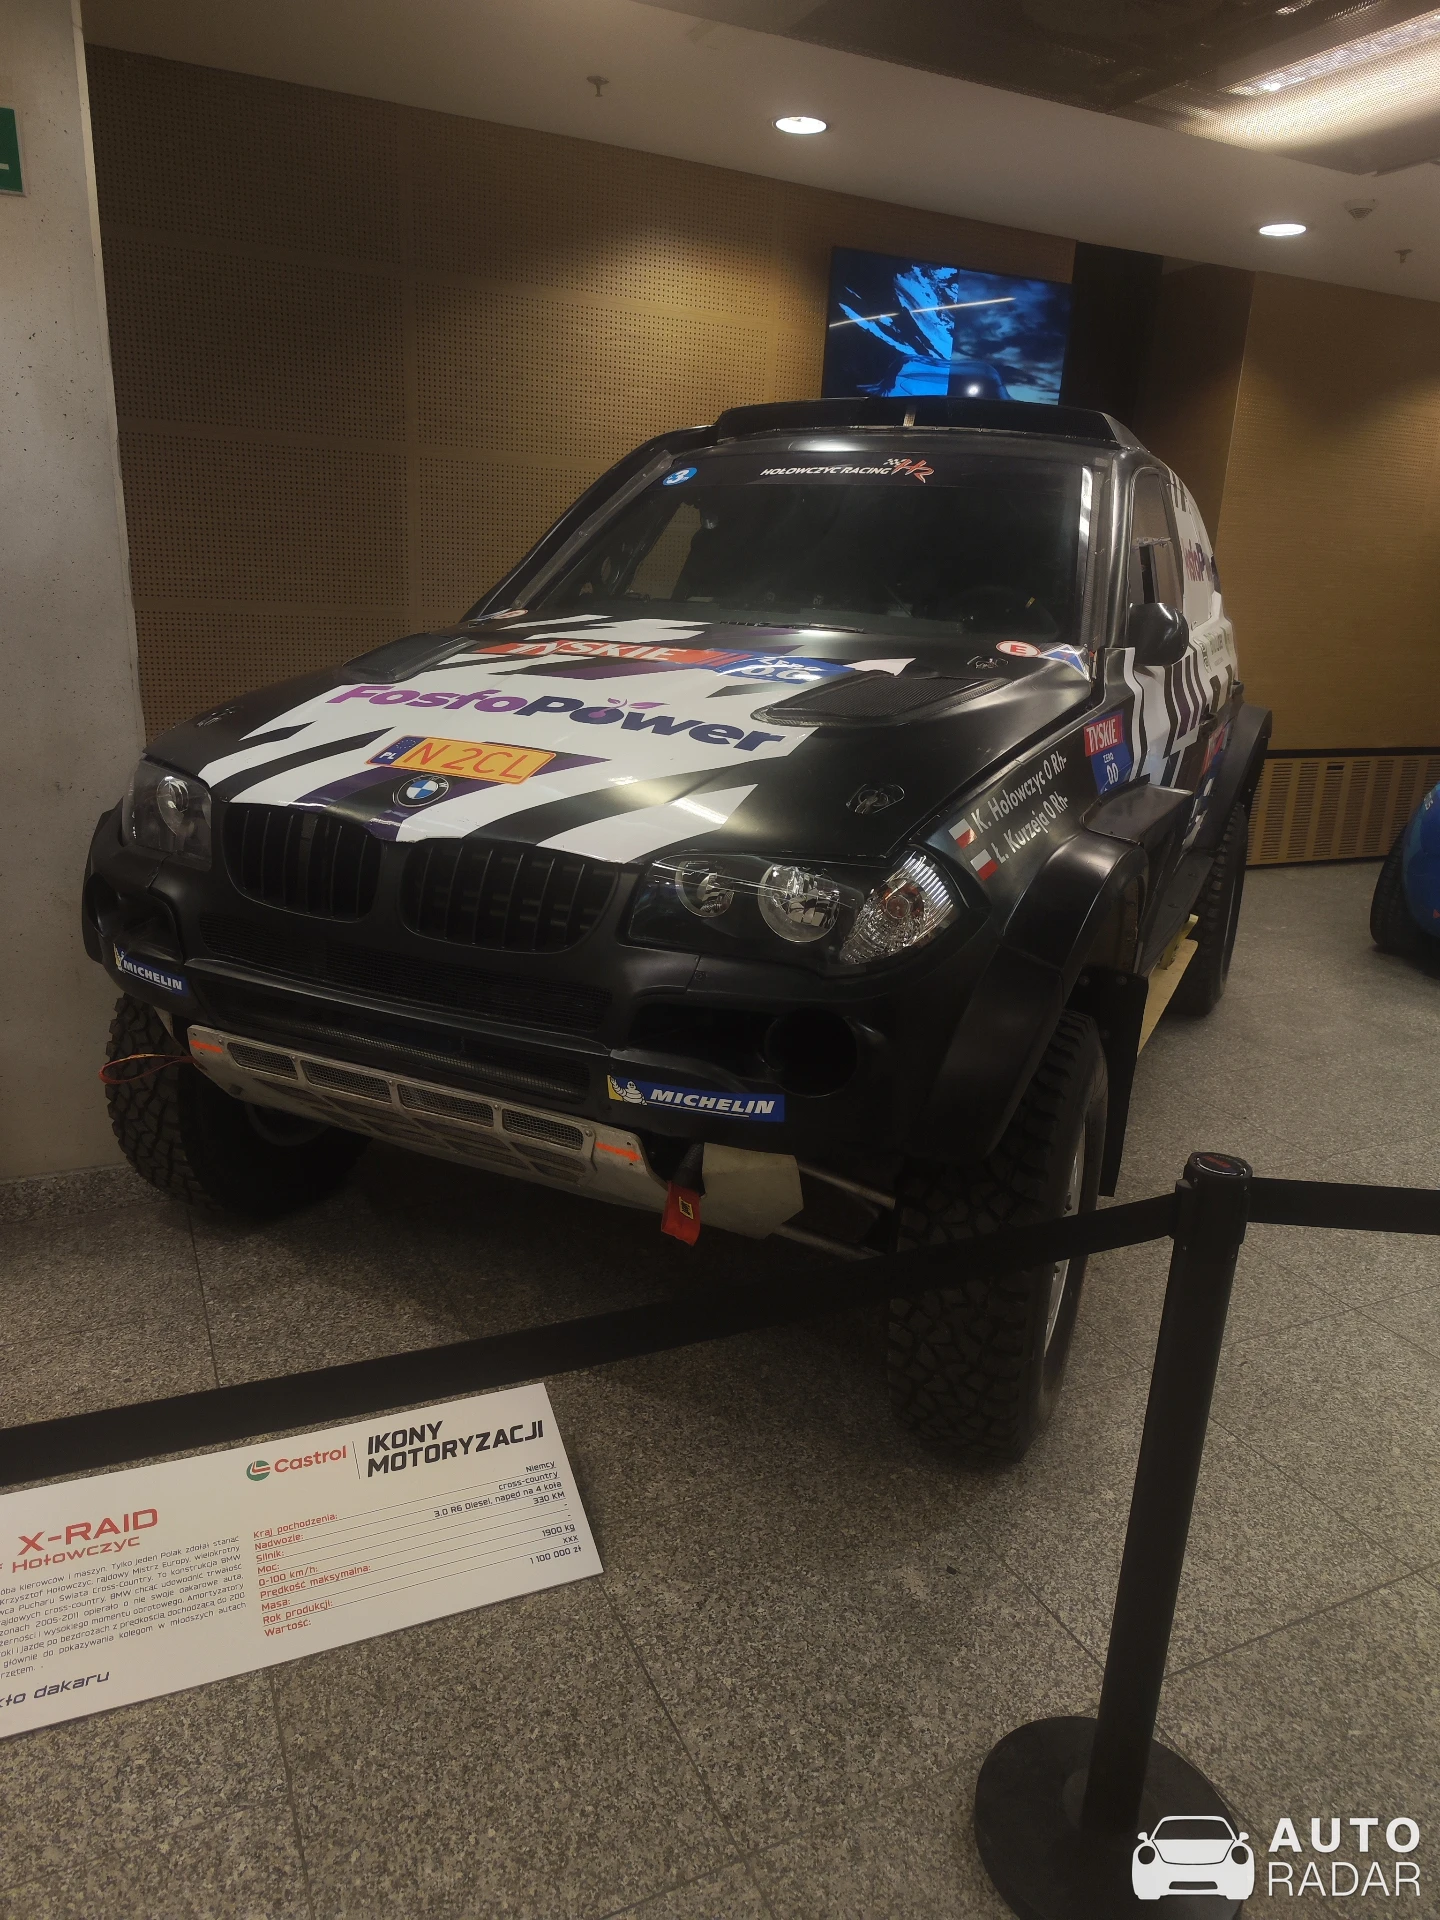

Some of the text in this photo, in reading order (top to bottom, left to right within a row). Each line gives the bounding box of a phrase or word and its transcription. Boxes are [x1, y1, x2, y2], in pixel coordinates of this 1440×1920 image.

[760, 467, 843, 475] HOŁOWCZYC
[841, 467, 892, 476] RACING
[506, 641, 687, 661] TYSKIE
[1010, 644, 1027, 654] E
[758, 656, 826, 671] ZERO
[325, 684, 787, 752] FosfoPower
[1086, 718, 1118, 753] TYSKIE
[379, 752, 397, 760] PL
[402, 742, 529, 779] N 2CL
[1103, 752, 1115, 763] ZERO
[971, 808, 991, 834] K.
[988, 770, 1045, 822] Hołowczyc
[1051, 750, 1067, 776] Rh-
[990, 843, 1009, 864] Ł.
[1003, 810, 1050, 853] Kurzeja
[1054, 791, 1069, 814] Rh-
[123, 959, 183, 991] MICHELIN
[650, 1089, 775, 1114] MICHELIN
[367, 1420, 443, 1456] IKONY
[367, 1420, 544, 1478] MOTORYZACJI
[274, 1445, 347, 1473] Castrol
[526, 1461, 555, 1473] Niemcy
[498, 1471, 558, 1491] cross-country
[434, 1509, 448, 1517] 3.0
[450, 1505, 463, 1514] R6
[465, 1497, 493, 1510] Diesel,
[523, 1487, 534, 1495] na
[535, 1485, 542, 1493] 4
[544, 1481, 562, 1491] koła
[533, 1491, 566, 1504] 330 KM
[17, 1508, 158, 1556] X-RAID
[254, 1513, 338, 1538] Kraj pochodzenia:
[542, 1524, 575, 1537] 1900 kg
[12, 1536, 140, 1573] Hołowczyc
[255, 1534, 304, 1550] Nadwozie:
[536, 1553, 551, 1563] 100
[553, 1548, 571, 1558] 000
[573, 1545, 581, 1553] zł
[256, 1550, 284, 1562] Silnik:
[19, 1576, 65, 1591] kierowców
[111, 1560, 133, 1570] Tylko
[134, 1555, 158, 1566] jeden
[160, 1549, 182, 1559] Polak
[96, 1571, 130, 1583] rajdowy
[132, 1564, 159, 1575] Mistrz
[257, 1564, 280, 1575] Moc:
[258, 1565, 318, 1587] 0-100 km/h:
[260, 1565, 371, 1599] Prędkość maksymalna:
[18, 1598, 55, 1611] Pucharu
[170, 1560, 218, 1575] konstrukcja
[220, 1554, 241, 1564] BMW
[110, 1589, 132, 1600] BMW
[35, 1612, 79, 1628] 2005-2011
[83, 1603, 119, 1616] opierało
[133, 1596, 146, 1604] nie
[151, 1590, 175, 1601] swoje
[179, 1580, 219, 1594] dakarowe
[43, 1621, 89, 1636] wysokiego
[91, 1611, 131, 1624] momentu
[187, 1583, 244, 1601] Amortyzatory
[261, 1599, 290, 1611] Masa:
[263, 1599, 333, 1625] Rok produkcji:
[20, 1641, 45, 1654] jazdę
[46, 1638, 58, 1647] po
[217, 1597, 227, 1605] do
[229, 1591, 246, 1602] 200
[43, 1650, 54, 1658] do
[58, 1635, 114, 1654] pokazywania
[119, 1626, 154, 1639] kolegom
[170, 1610, 214, 1626] młodszych
[218, 1602, 247, 1614] autach
[264, 1619, 312, 1637] Wartość:
[34, 1671, 110, 1699] dakaru
